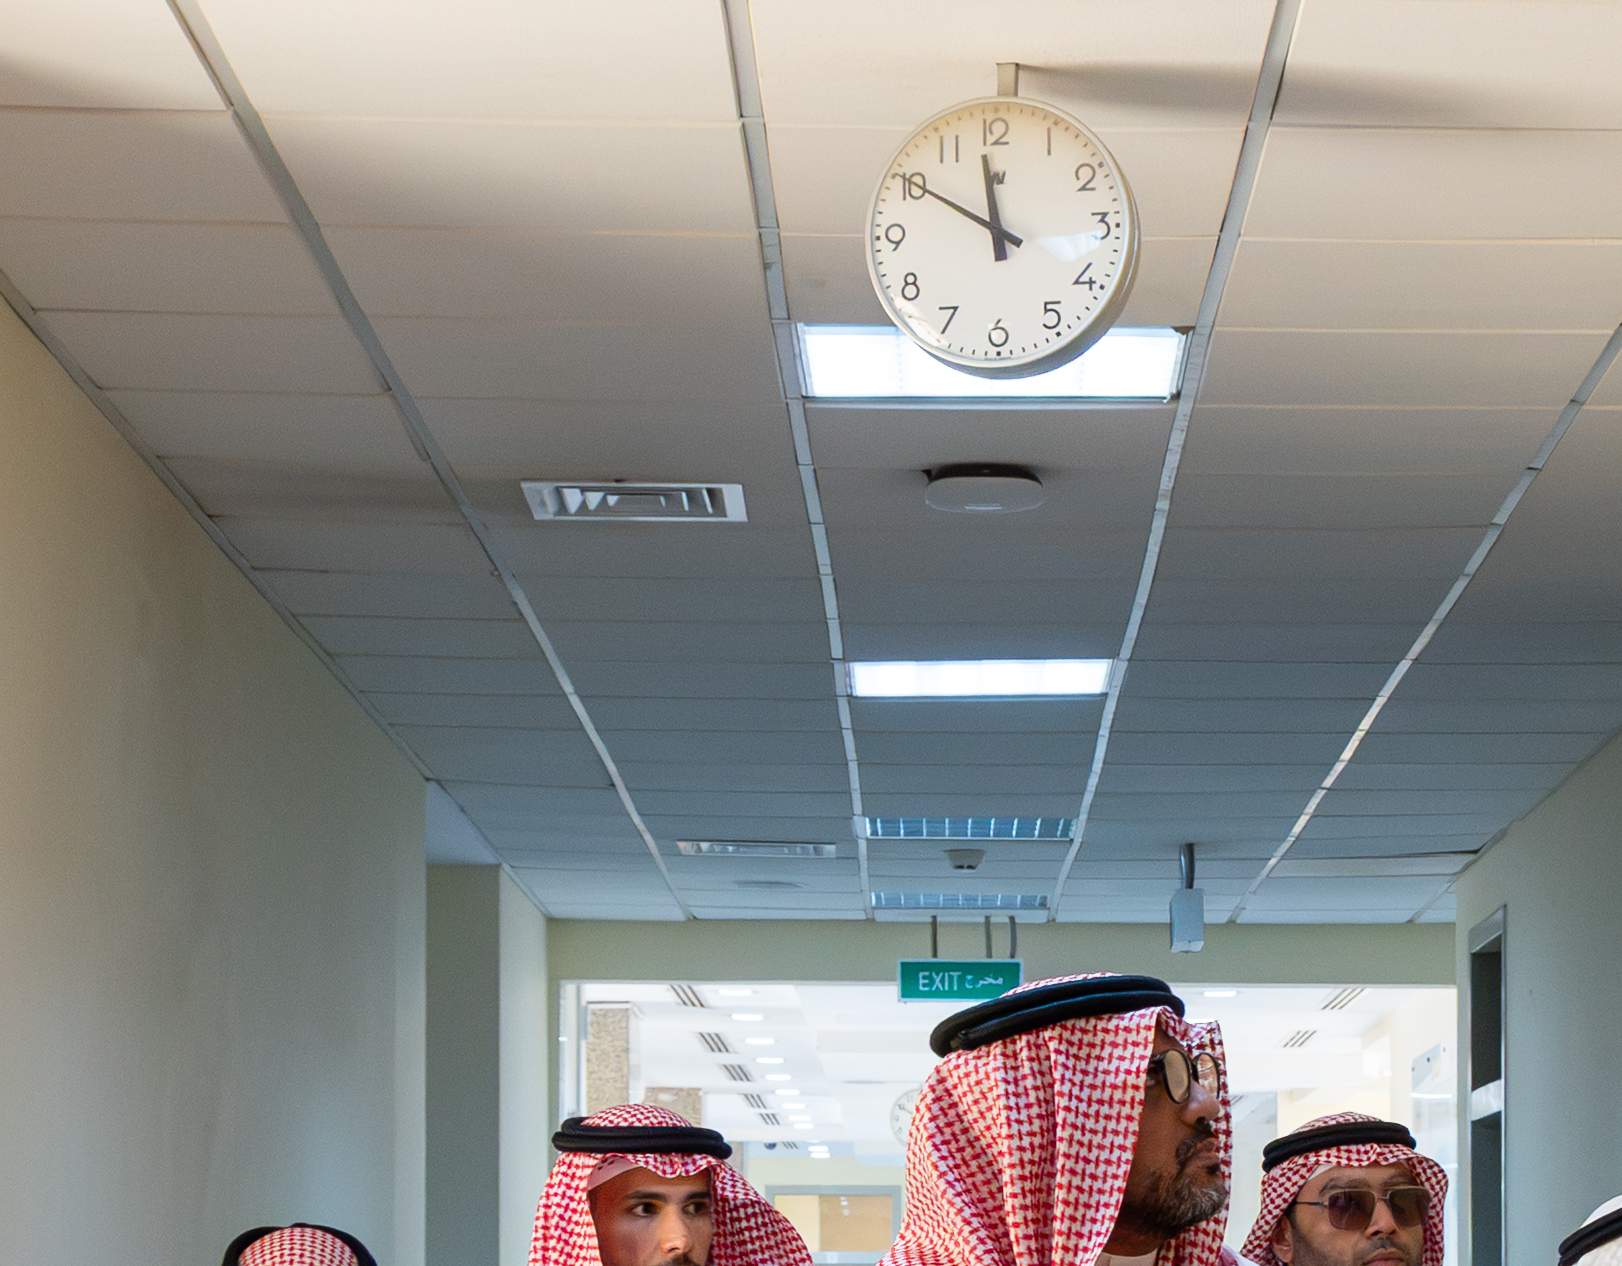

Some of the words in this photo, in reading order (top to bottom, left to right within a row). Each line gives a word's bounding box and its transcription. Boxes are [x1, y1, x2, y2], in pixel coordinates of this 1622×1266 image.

[982, 117, 1010, 147] 12
[1046, 126, 1052, 156] 1
[939, 134, 959, 164] 11
[901, 171, 927, 201] 10
[1075, 162, 1097, 193] 2
[884, 223, 906, 252] 9
[1090, 211, 1111, 241] 3
[901, 271, 921, 301] 8
[1071, 261, 1097, 292] 4
[938, 305, 960, 335] 7
[1042, 300, 1062, 330] 5
[988, 318, 1009, 348] 6
[918, 971, 962, 991] EXIT
[964, 973, 1004, 990] مخرج
